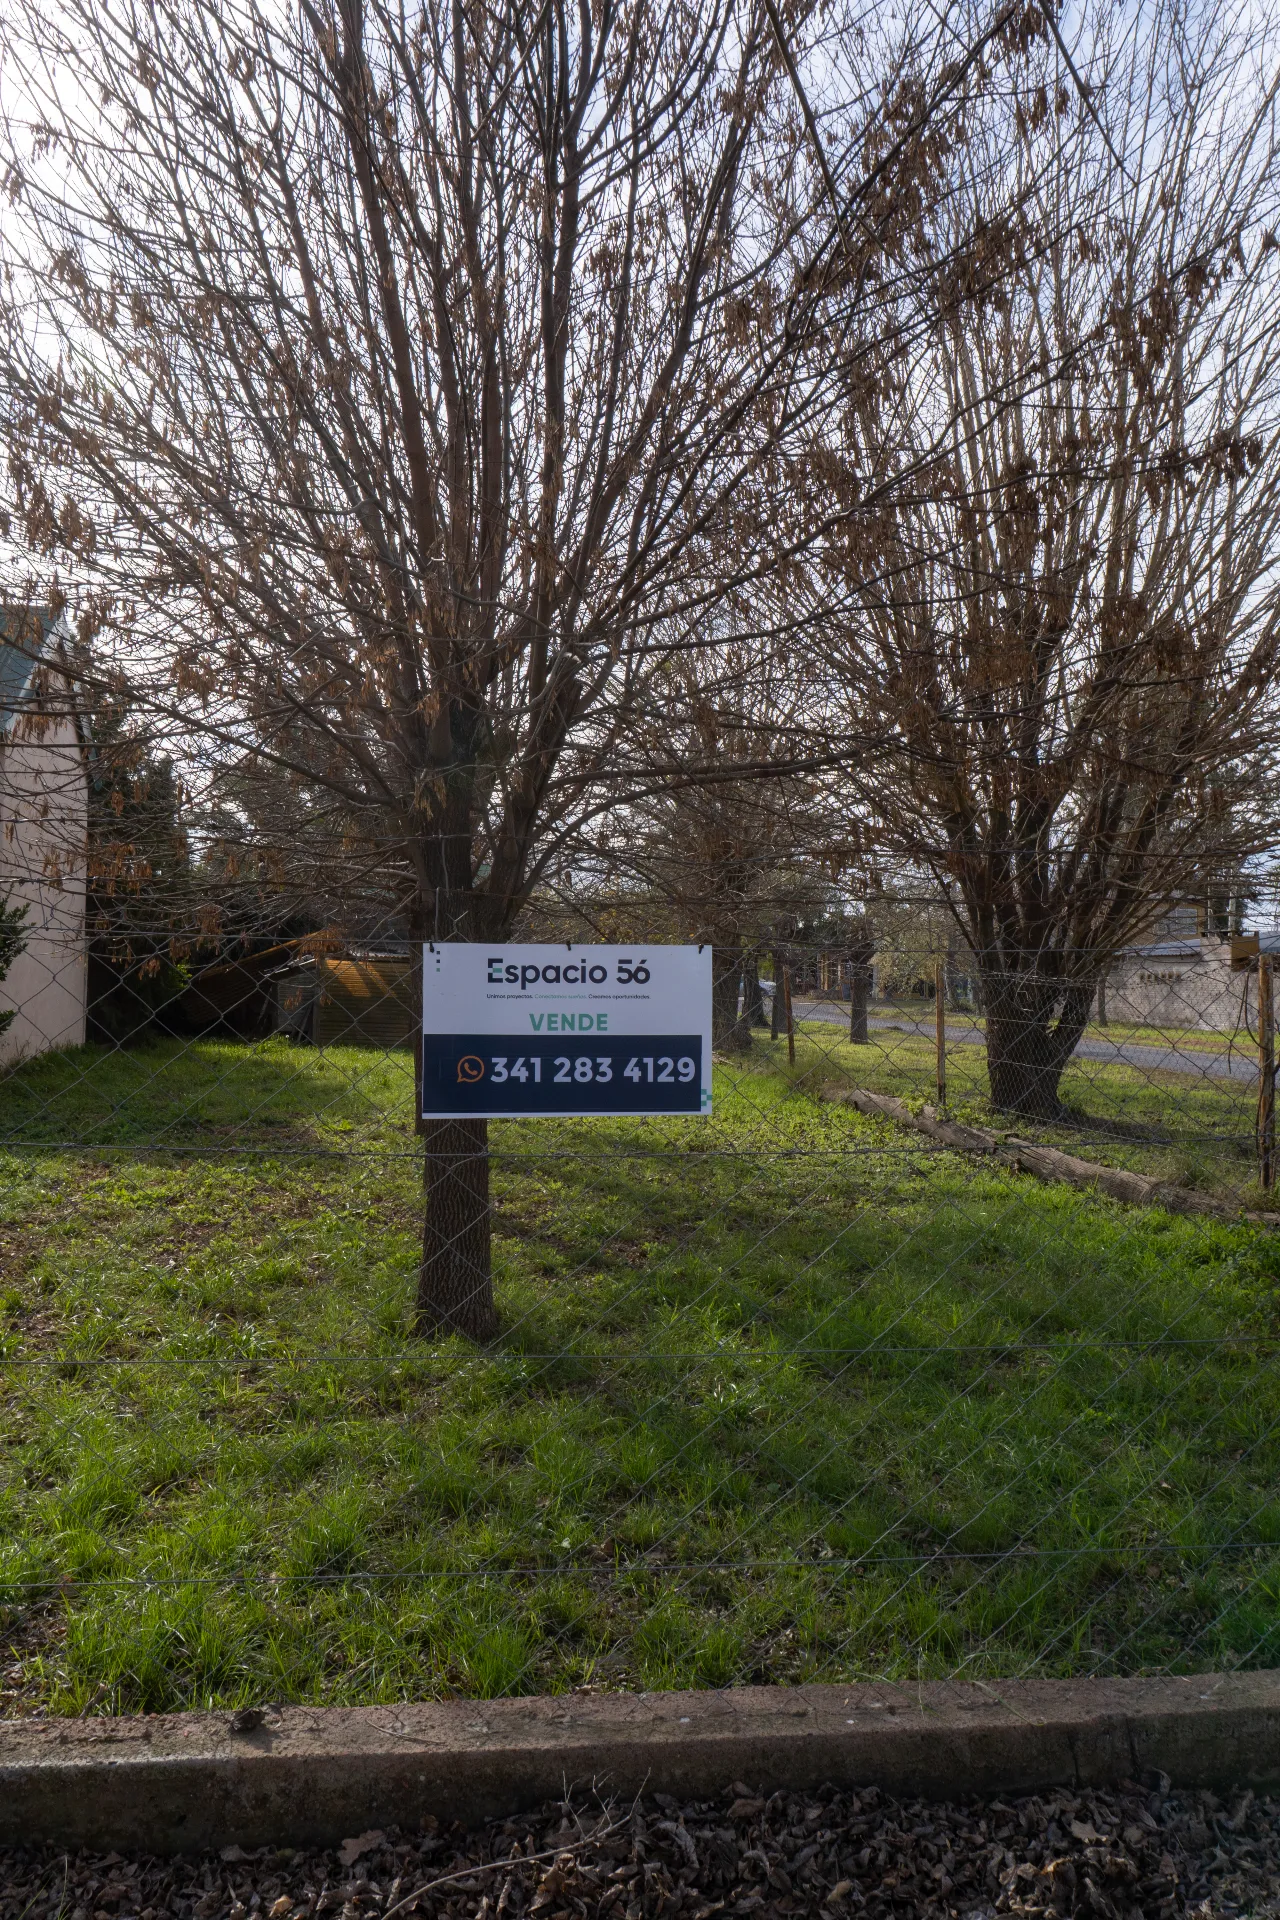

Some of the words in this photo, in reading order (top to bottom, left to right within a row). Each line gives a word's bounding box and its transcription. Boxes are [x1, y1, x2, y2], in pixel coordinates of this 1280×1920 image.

[488, 958, 607, 990] Espacio
[616, 959, 651, 984] 56
[529, 1013, 608, 1031] VENDE
[490, 1057, 541, 1082] 341
[554, 1057, 613, 1082] 283
[624, 1057, 696, 1082] 4129
